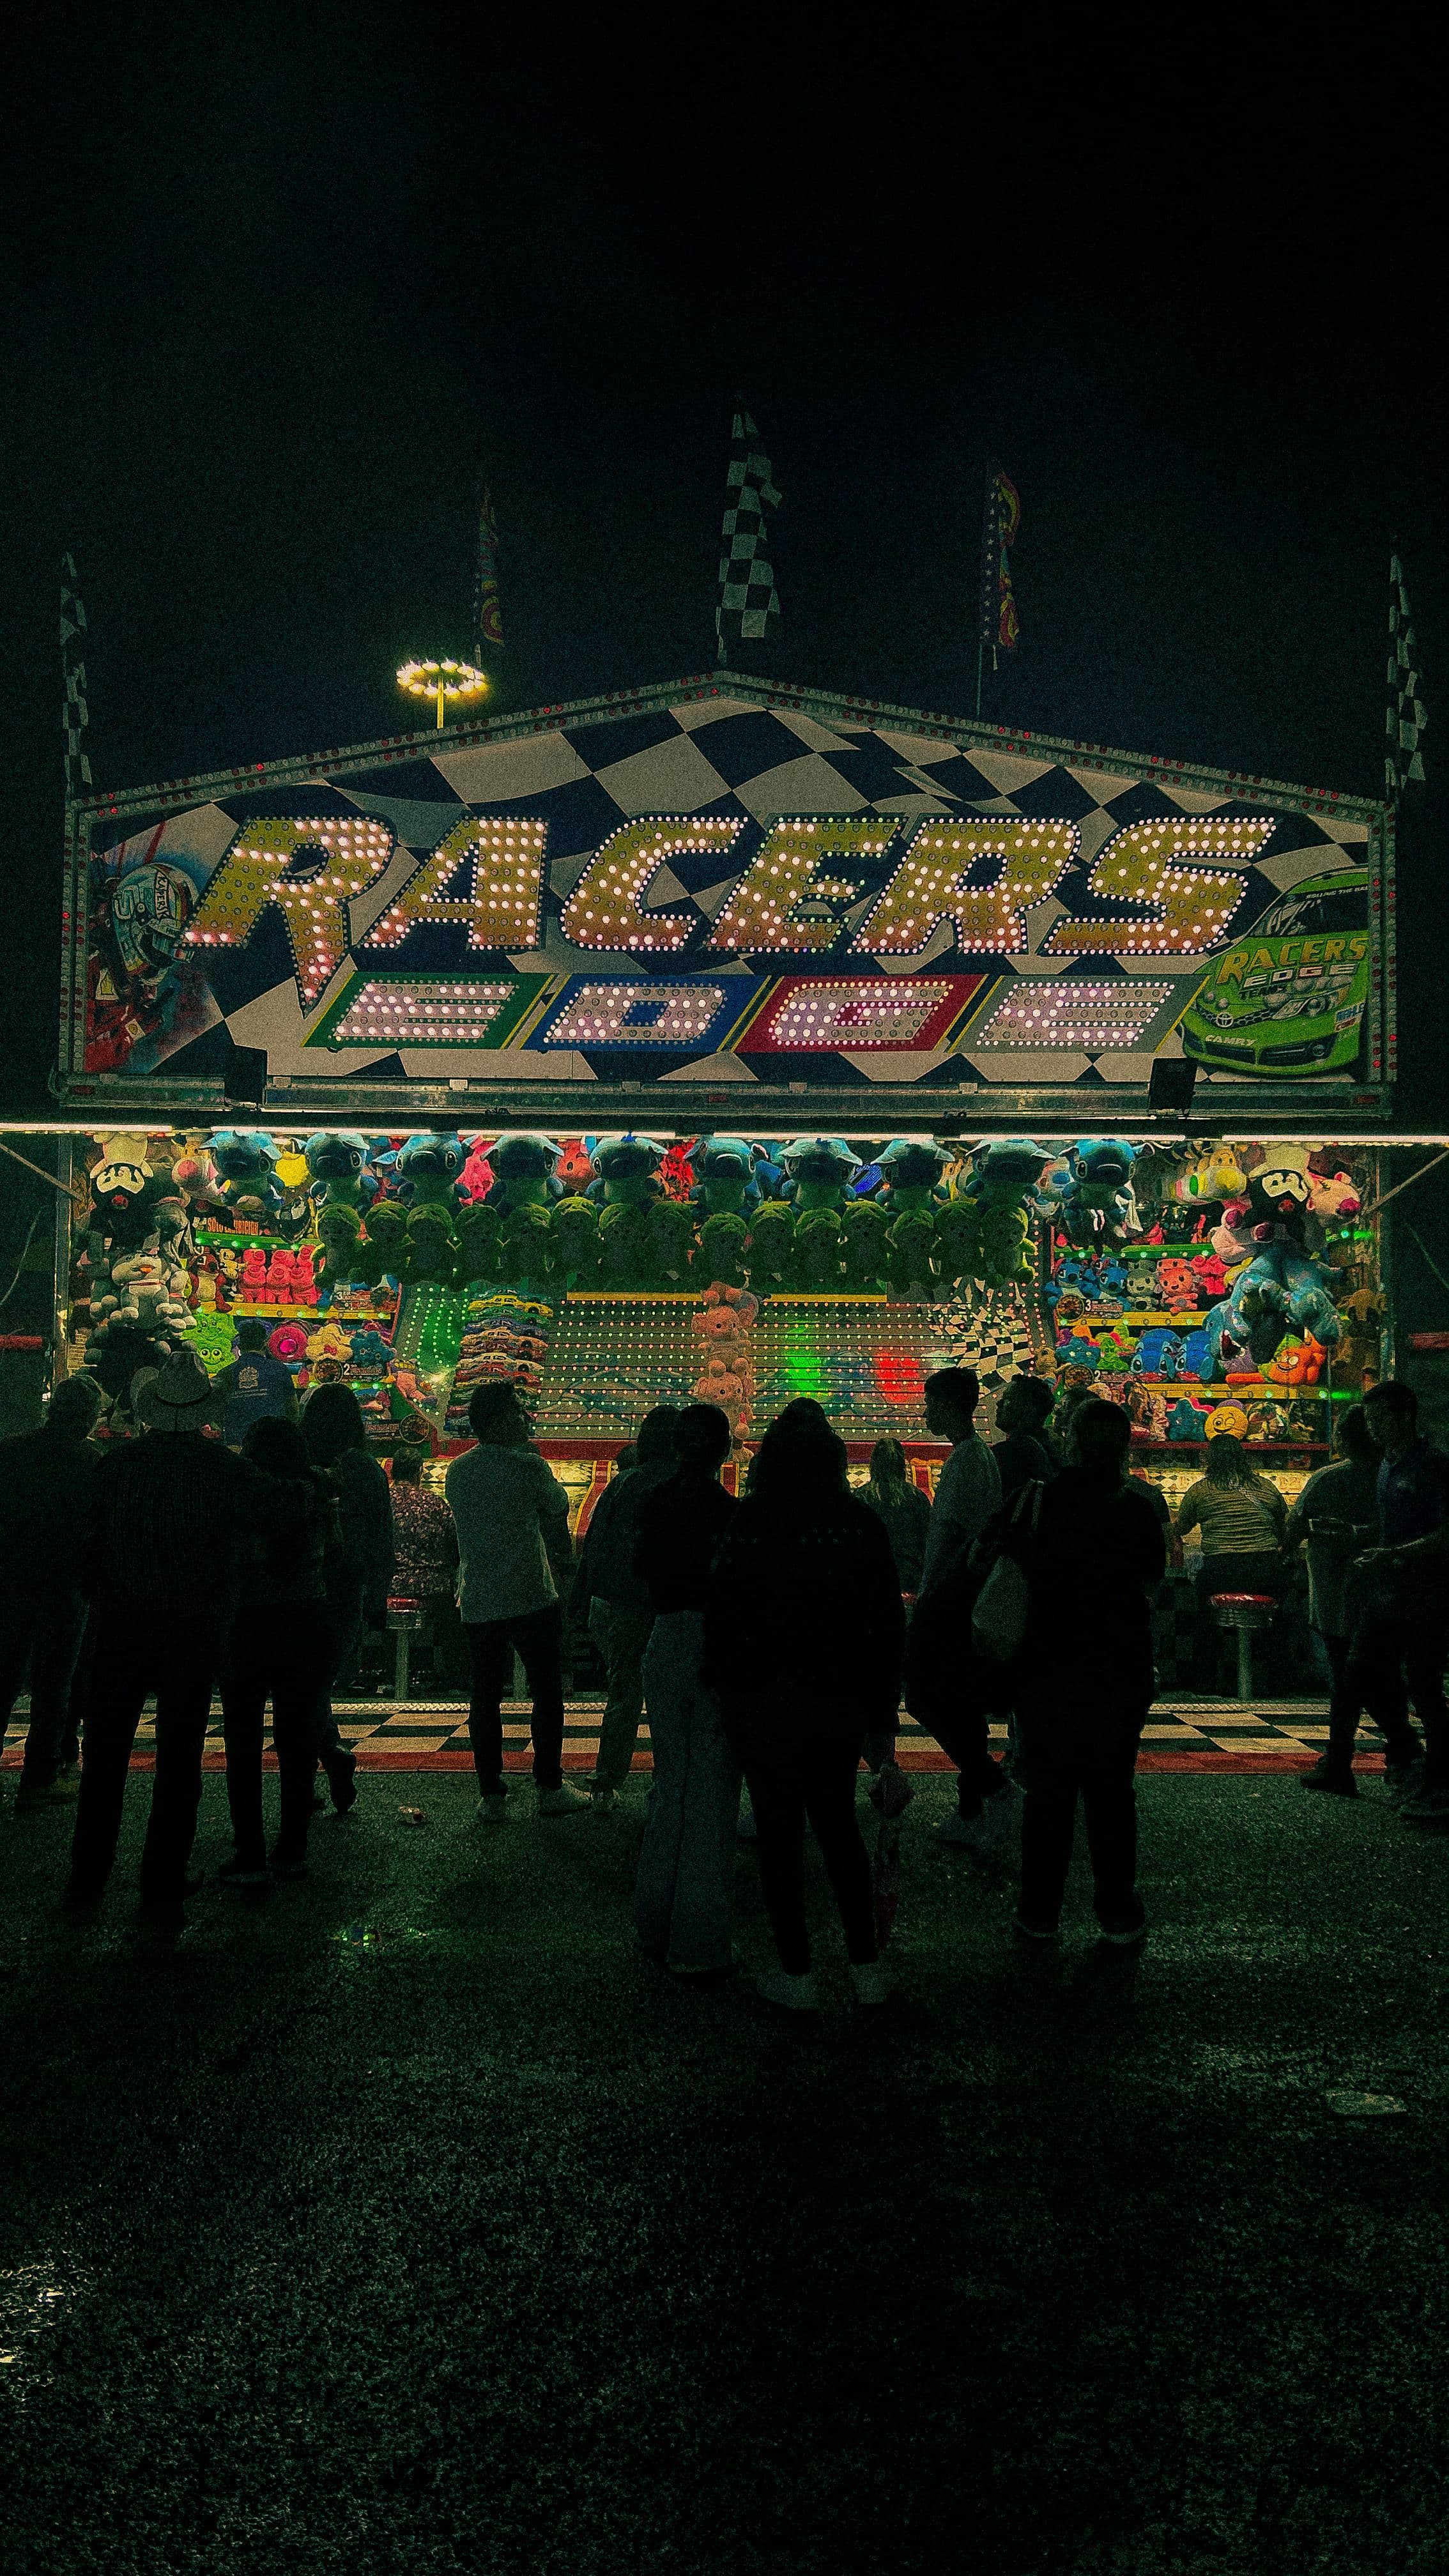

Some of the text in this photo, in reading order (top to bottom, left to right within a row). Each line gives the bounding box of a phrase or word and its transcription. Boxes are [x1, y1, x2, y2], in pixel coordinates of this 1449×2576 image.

[178, 815, 1276, 1017] RACERS
[1216, 937, 1369, 985] RACERS
[1243, 963, 1356, 988] EDGE
[327, 979, 1177, 1044] EDGE
[1205, 1034, 1257, 1046] CAMRY
